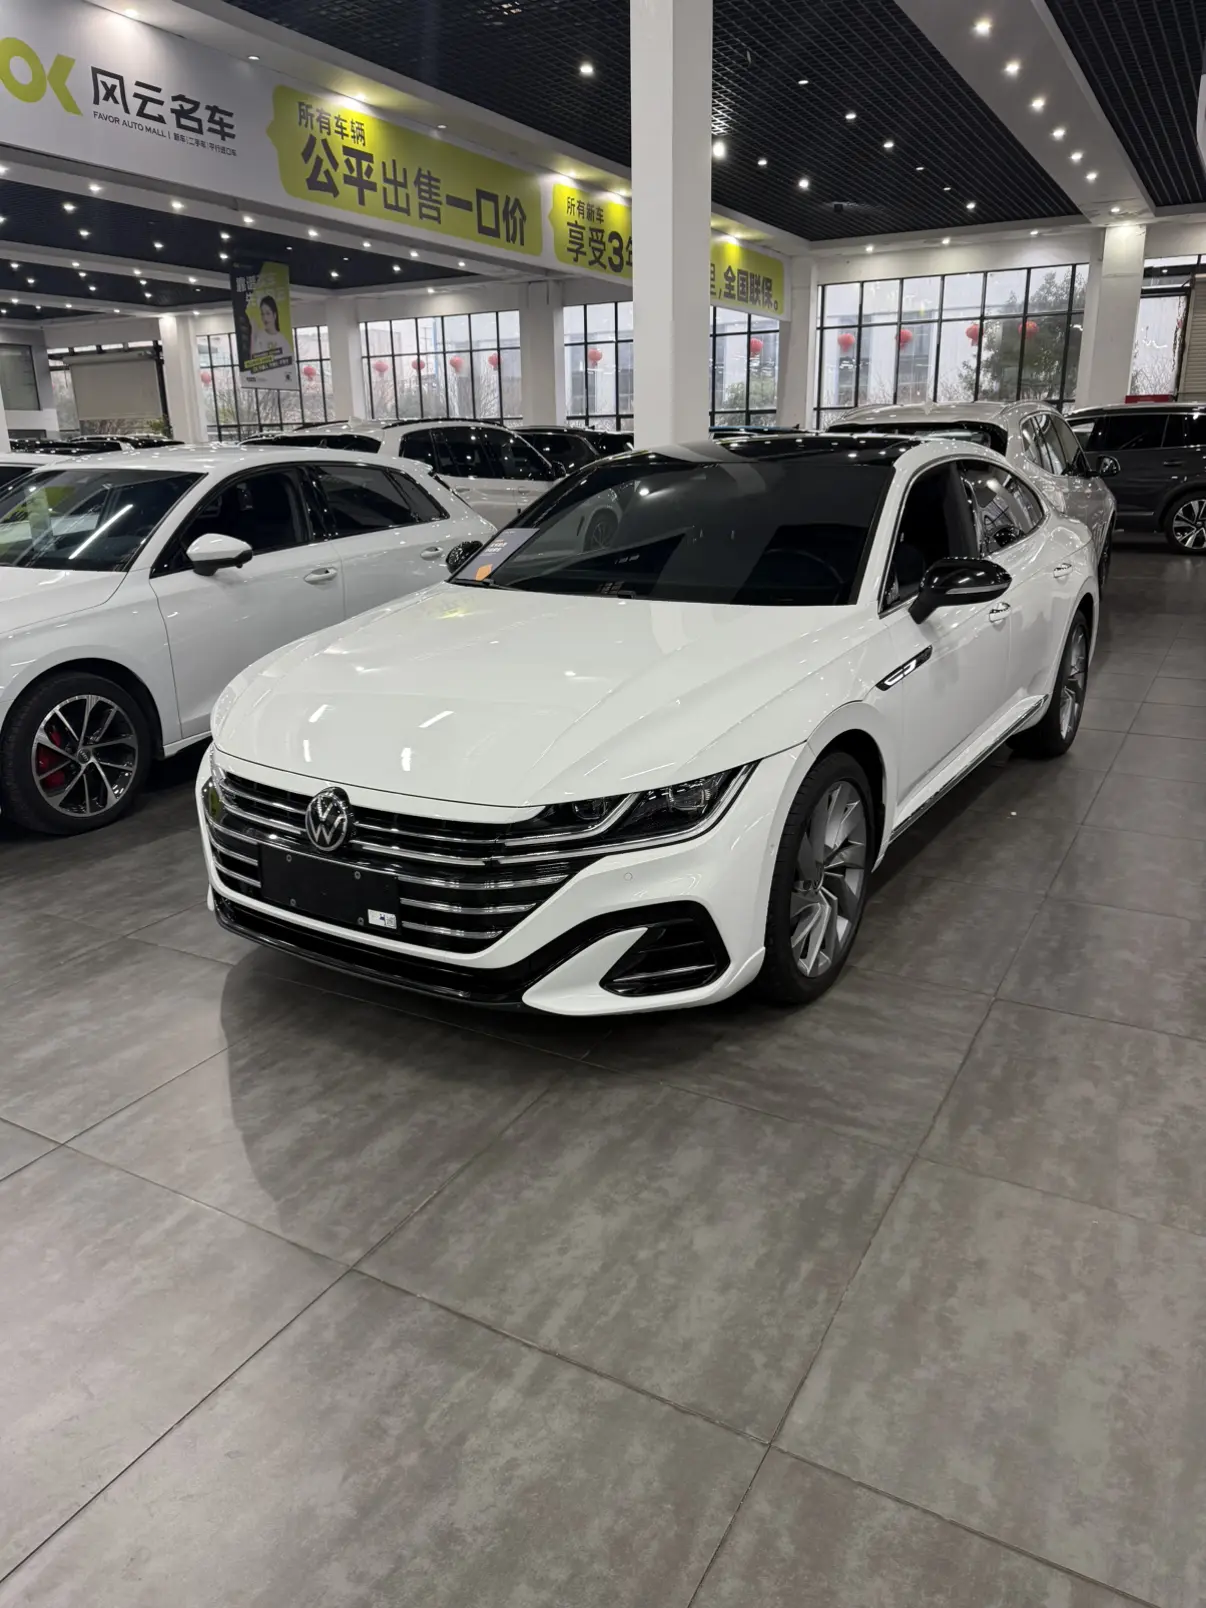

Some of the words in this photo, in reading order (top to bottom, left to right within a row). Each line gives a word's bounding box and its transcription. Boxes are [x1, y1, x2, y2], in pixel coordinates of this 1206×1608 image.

[91, 66, 236, 141] 风云名车
[93, 111, 120, 125] FAVOR
[122, 120, 144, 131] AUTO
[145, 126, 166, 138] MALL
[298, 102, 366, 146] 所有车辆
[301, 134, 527, 246] 公平出售一口价
[567, 196, 604, 224] 所有新车
